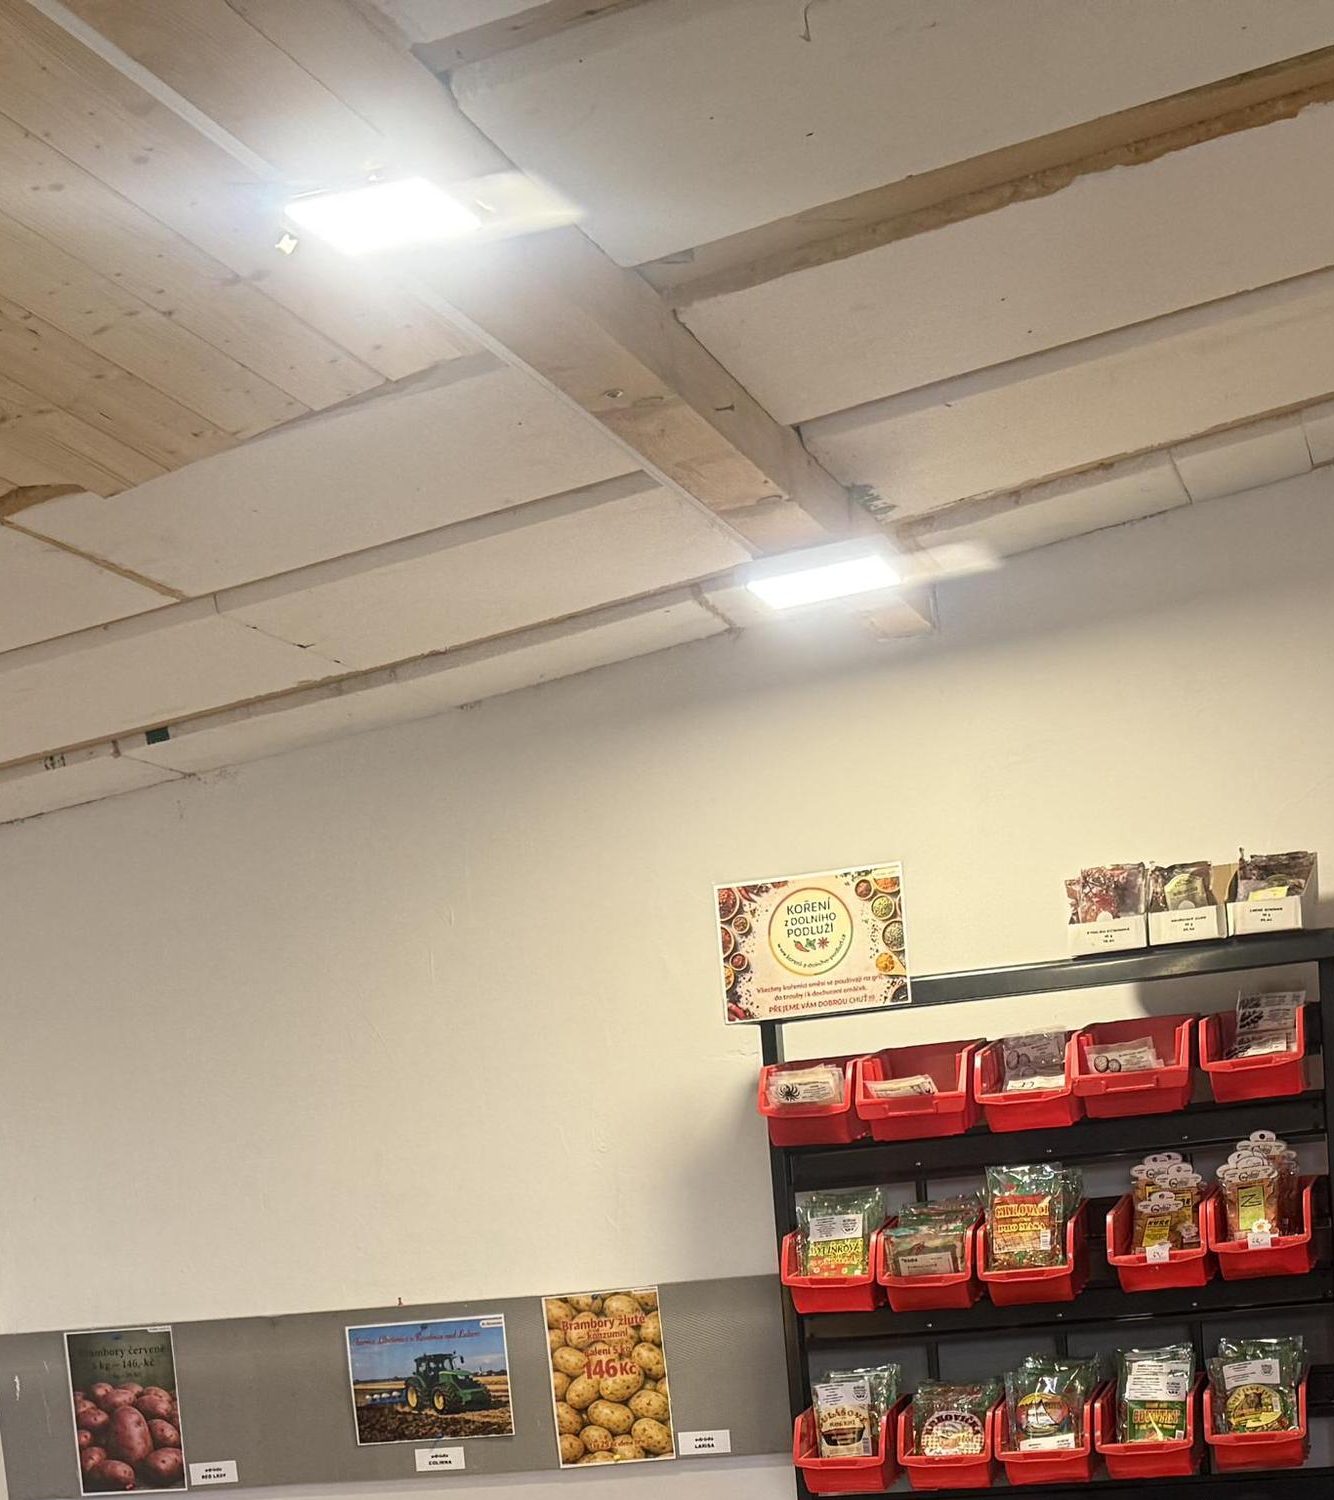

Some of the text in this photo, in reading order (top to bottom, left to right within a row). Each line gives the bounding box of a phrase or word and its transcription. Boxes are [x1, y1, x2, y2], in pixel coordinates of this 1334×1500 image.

[787, 897, 831, 915] KOŘENÍ
[790, 912, 836, 926] DOLNÍHO
[787, 923, 834, 937] PODLUŽÍ
[801, 1001, 817, 1011] VÁM
[818, 998, 848, 1008] DOBROU
[562, 1314, 645, 1332] Brambory žluté
[613, 1346, 618, 1354] 5
[583, 1359, 637, 1380] 146 Kč
